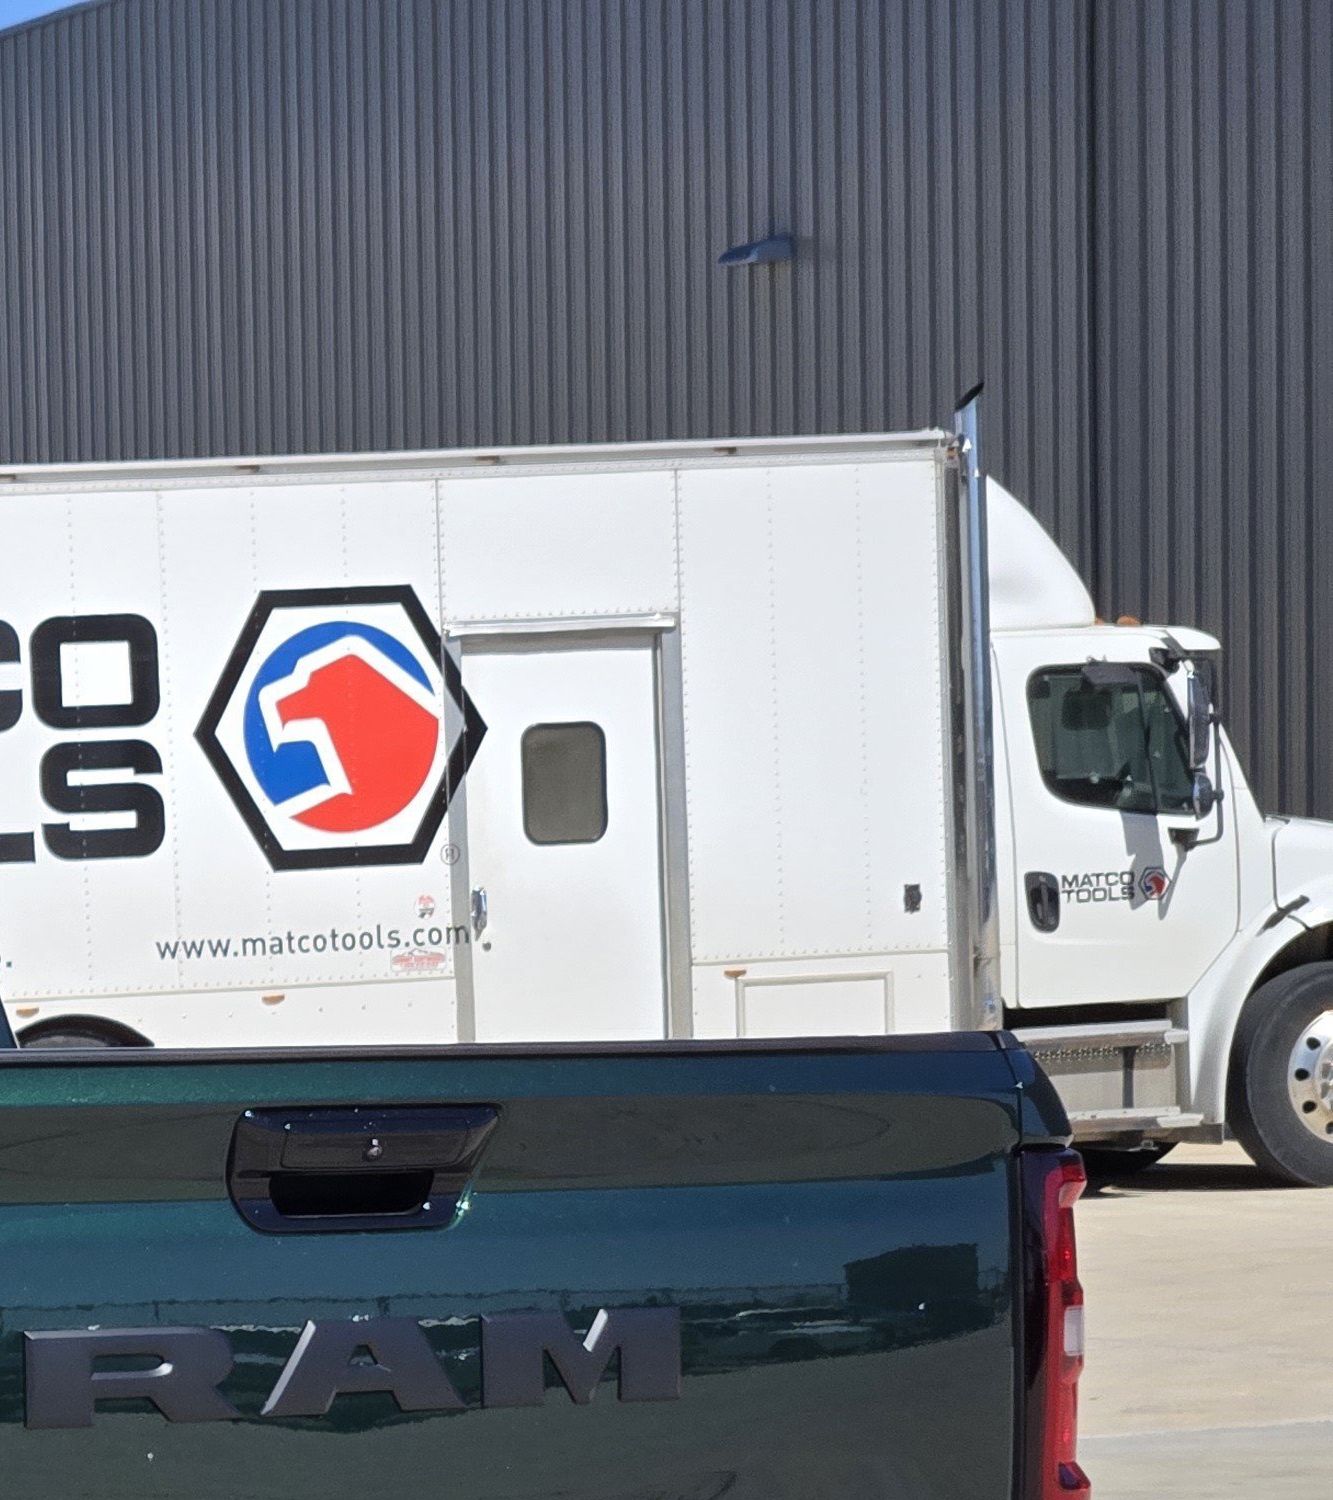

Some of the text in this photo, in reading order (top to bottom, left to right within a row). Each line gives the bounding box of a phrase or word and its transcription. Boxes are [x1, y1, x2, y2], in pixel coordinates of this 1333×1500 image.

[1061, 871, 1134, 888] MATCO
[1061, 886, 1134, 903] TOOLS
[155, 923, 470, 961] www.matcotools.com
[22, 1305, 681, 1430] RAM
